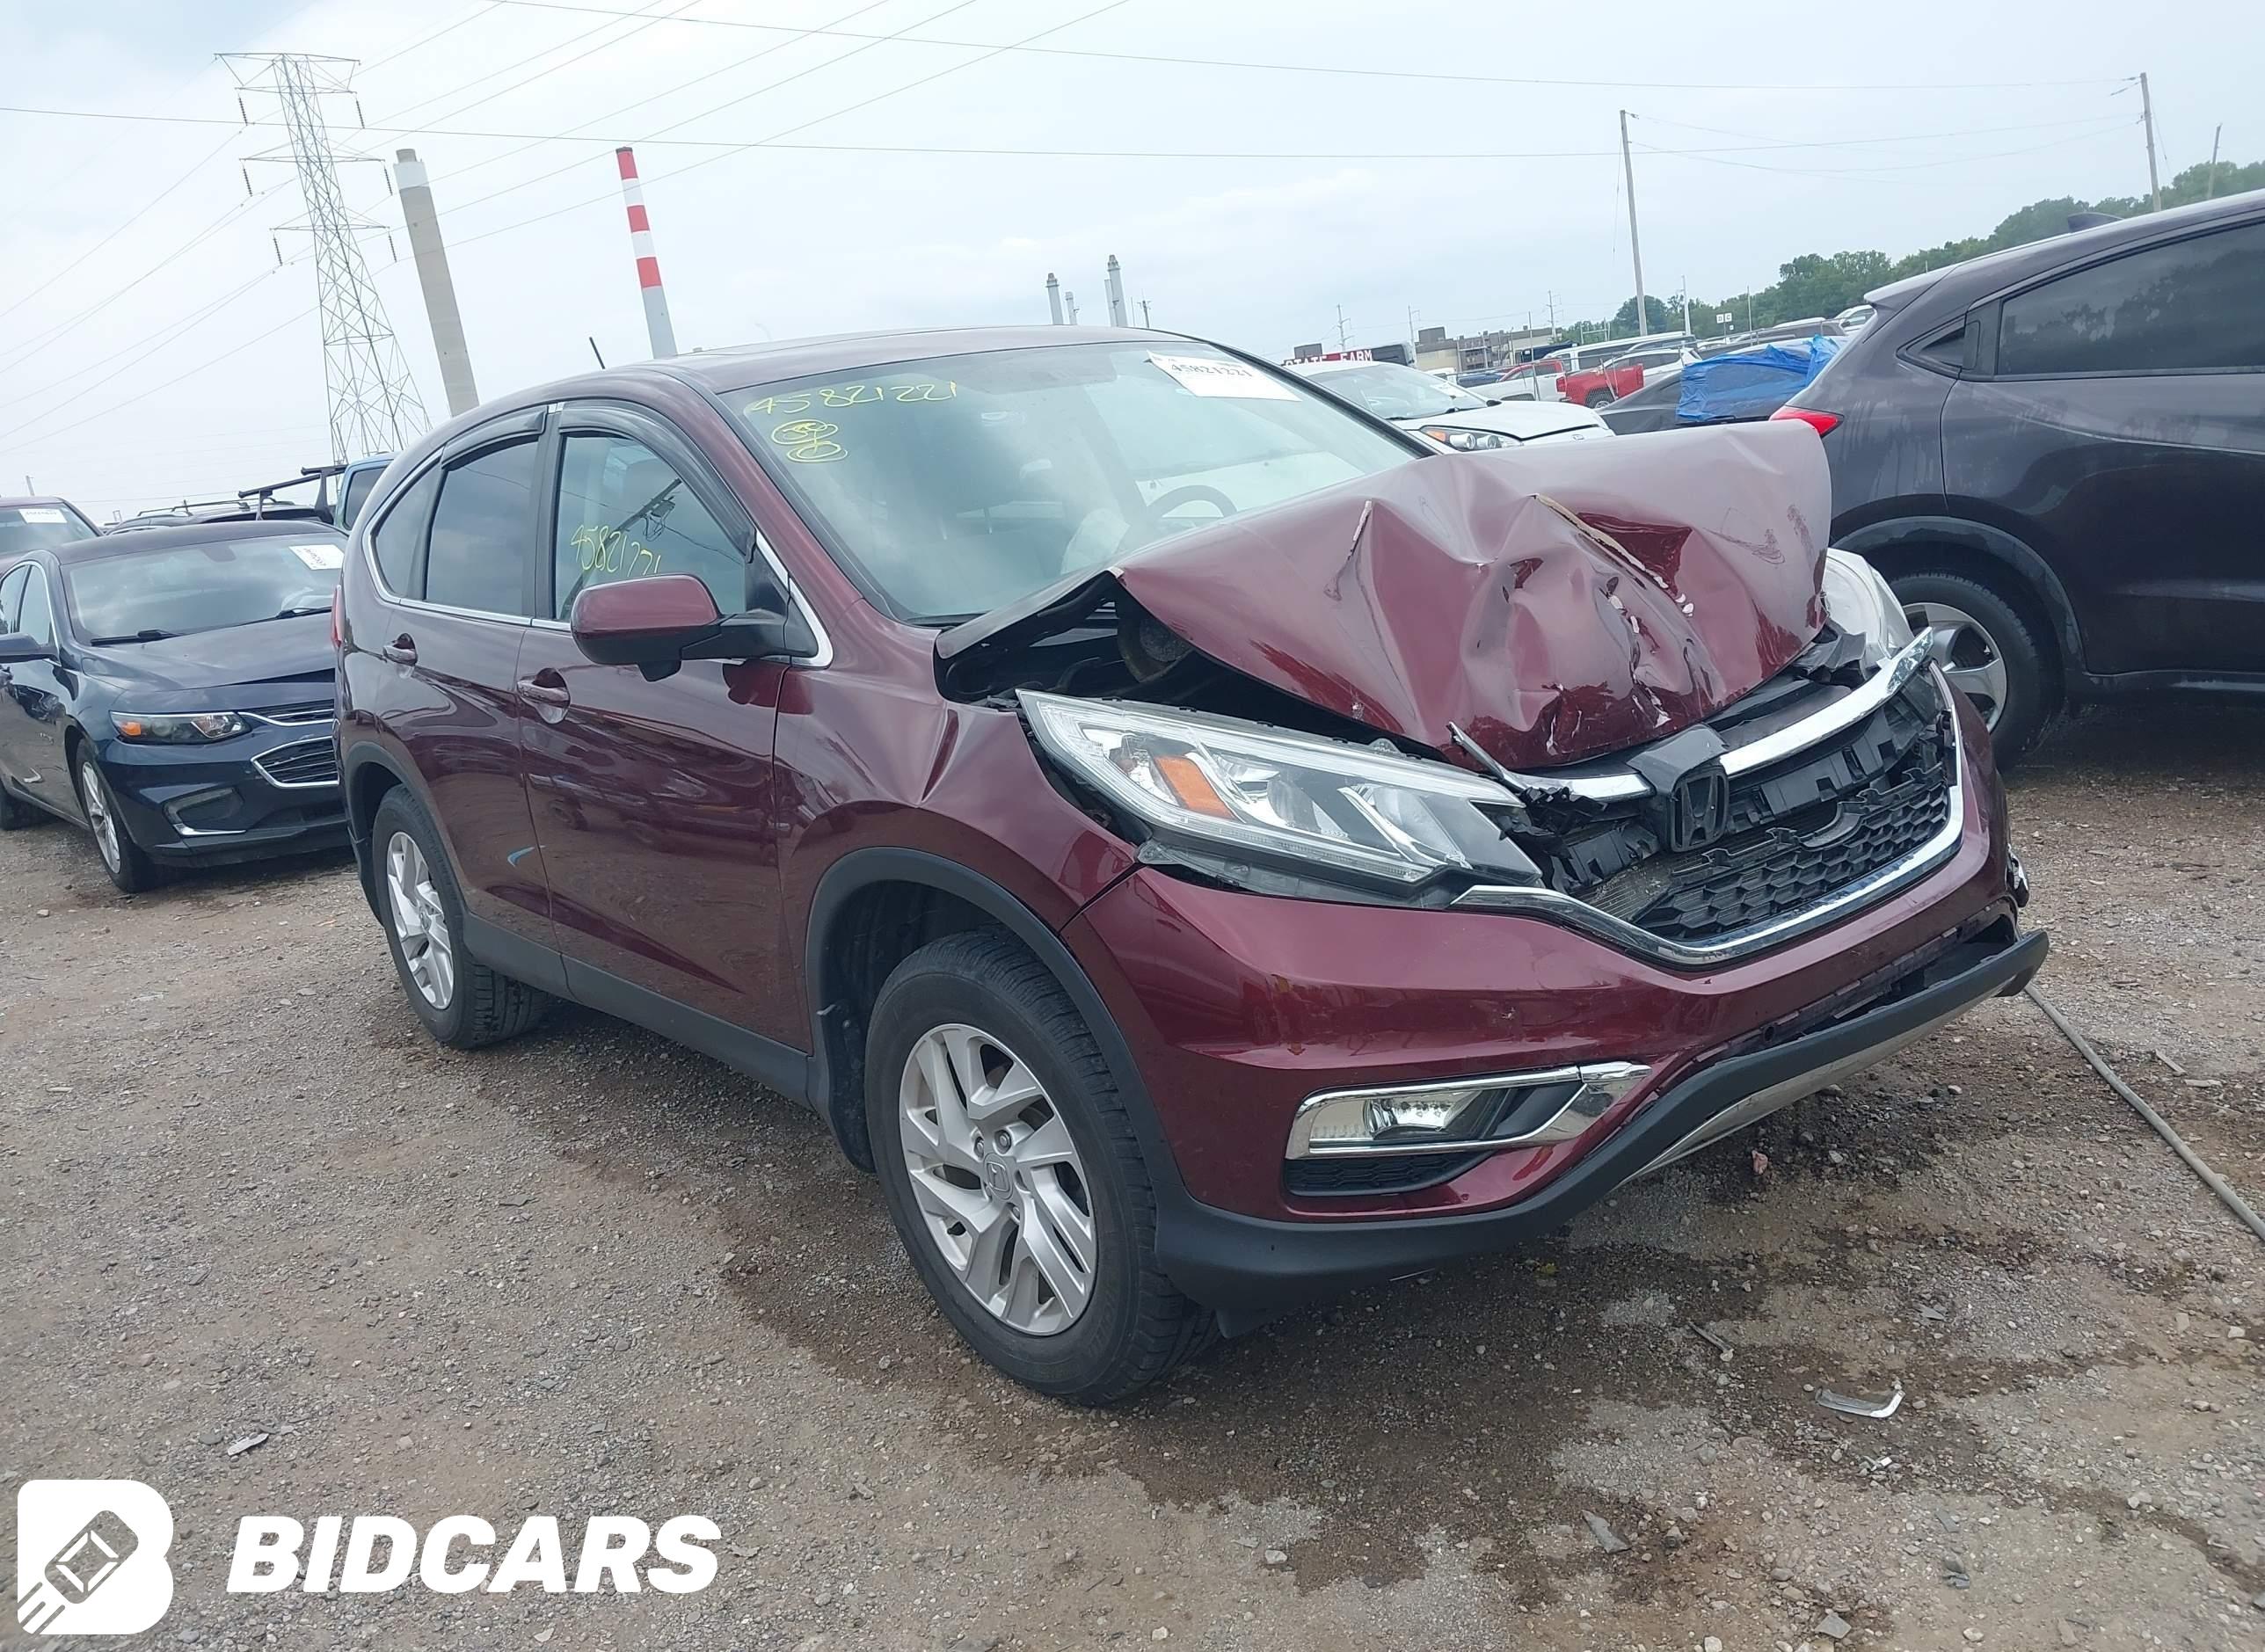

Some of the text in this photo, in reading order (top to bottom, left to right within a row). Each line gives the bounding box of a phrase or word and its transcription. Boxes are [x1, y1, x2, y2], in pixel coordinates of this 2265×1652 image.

[1340, 350, 1373, 363] FARM
[1171, 363, 1253, 378] 45821221
[752, 381, 957, 414] 45821221
